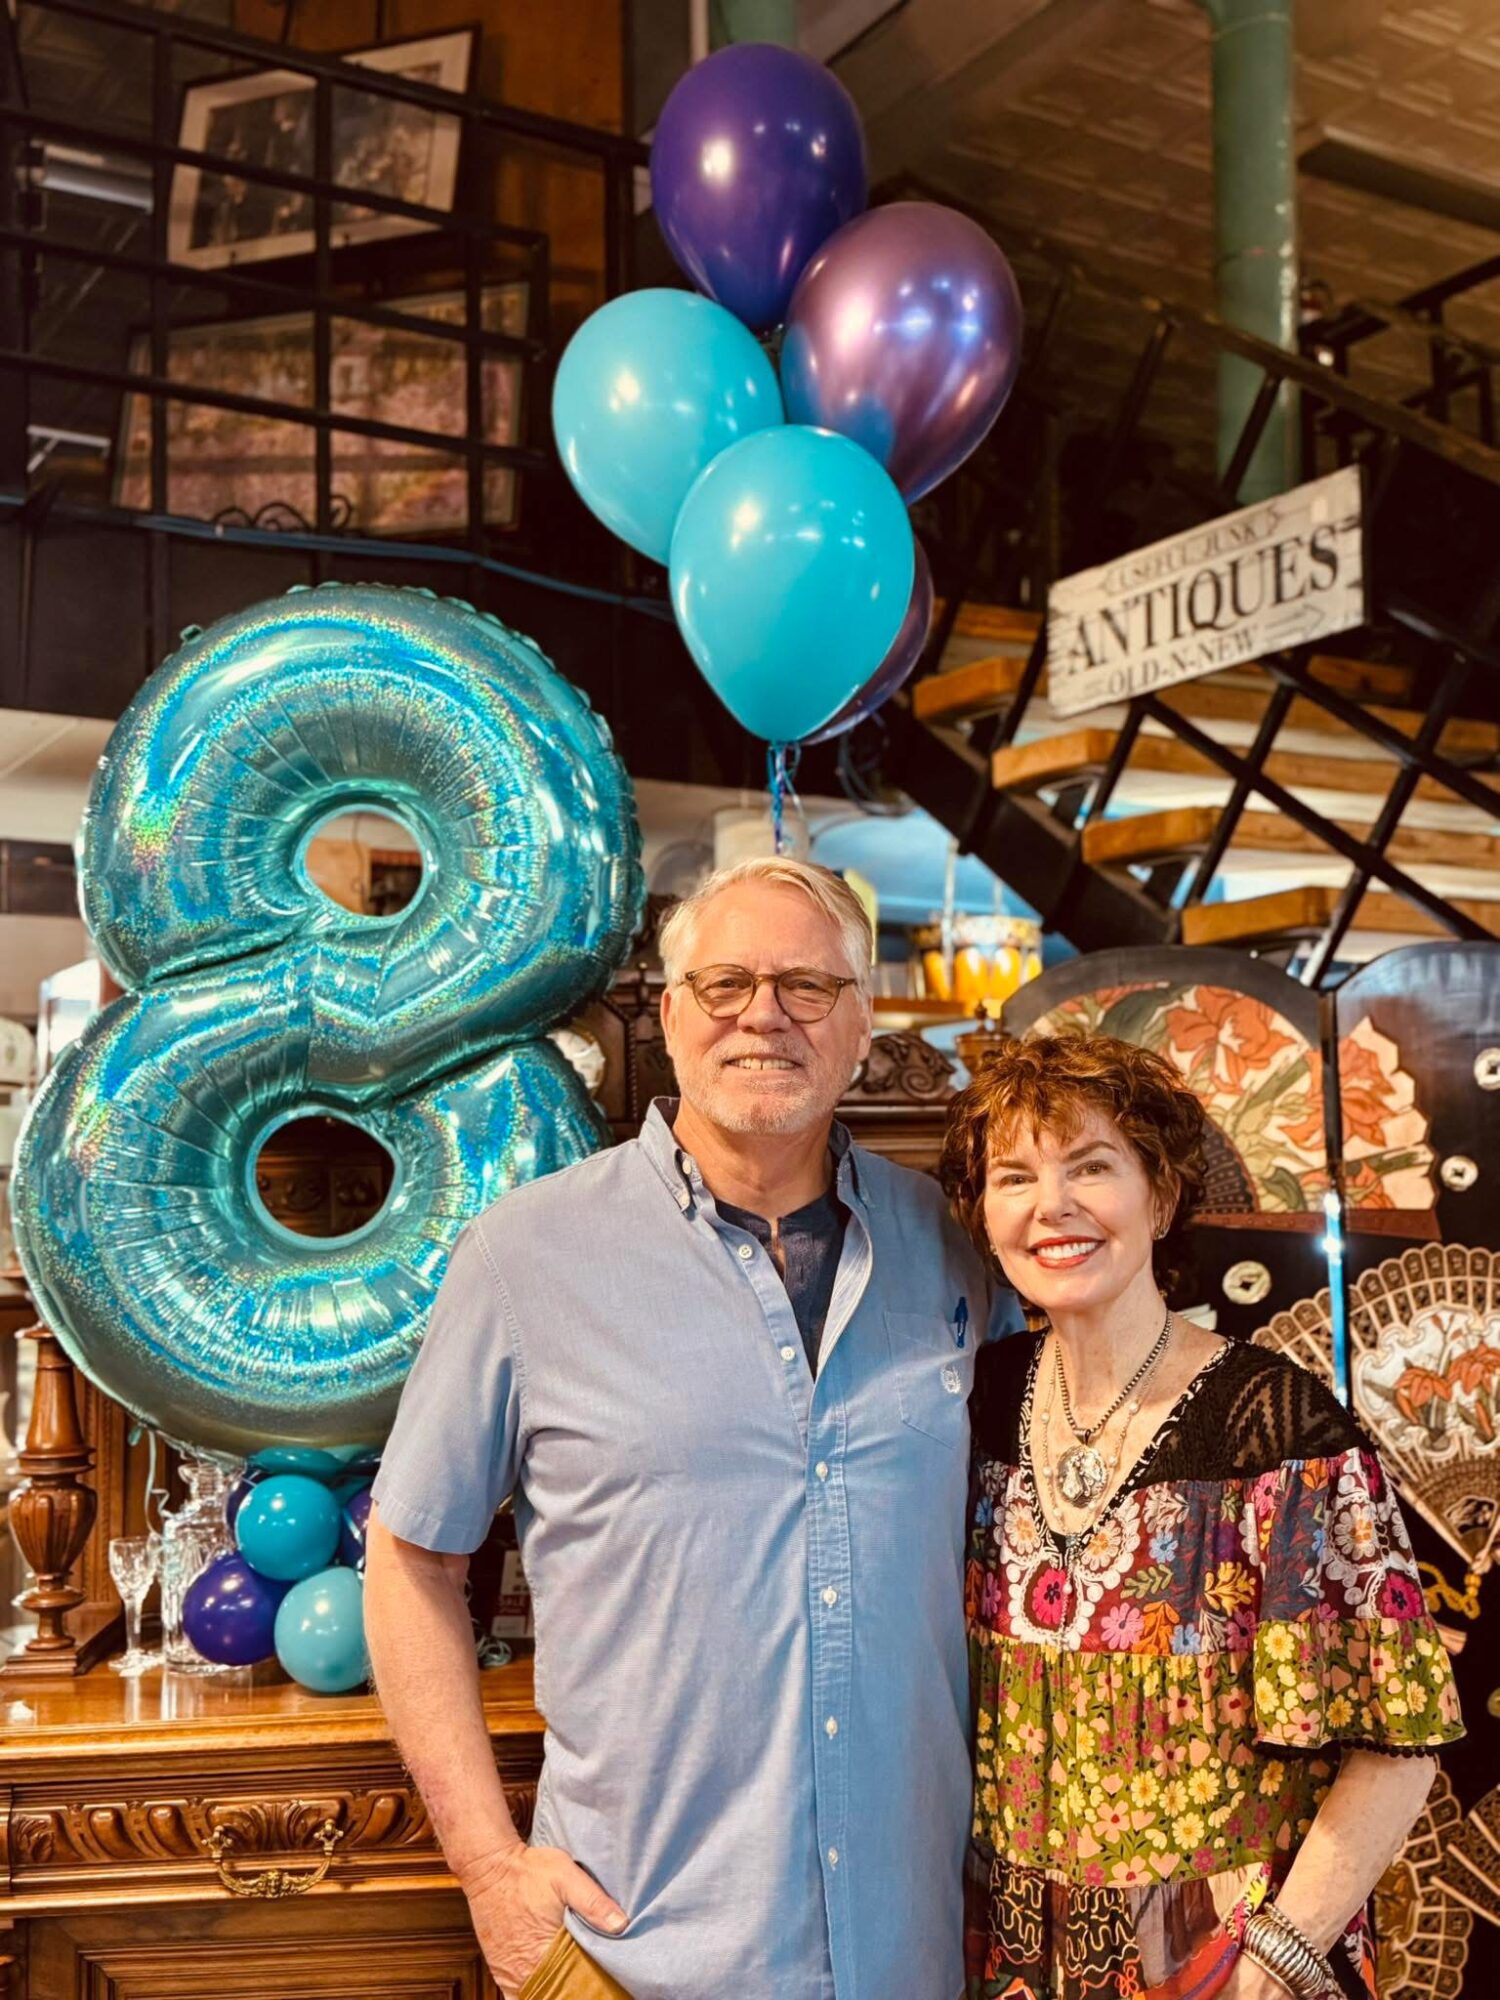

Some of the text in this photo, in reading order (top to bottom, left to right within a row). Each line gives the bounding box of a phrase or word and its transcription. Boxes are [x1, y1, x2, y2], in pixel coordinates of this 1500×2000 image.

[1203, 519, 1261, 558] JUNK
[1068, 524, 1339, 676] ANTIQUES
[1108, 624, 1257, 694] OLD-N-NEW
[12, 581, 645, 1462] 8
